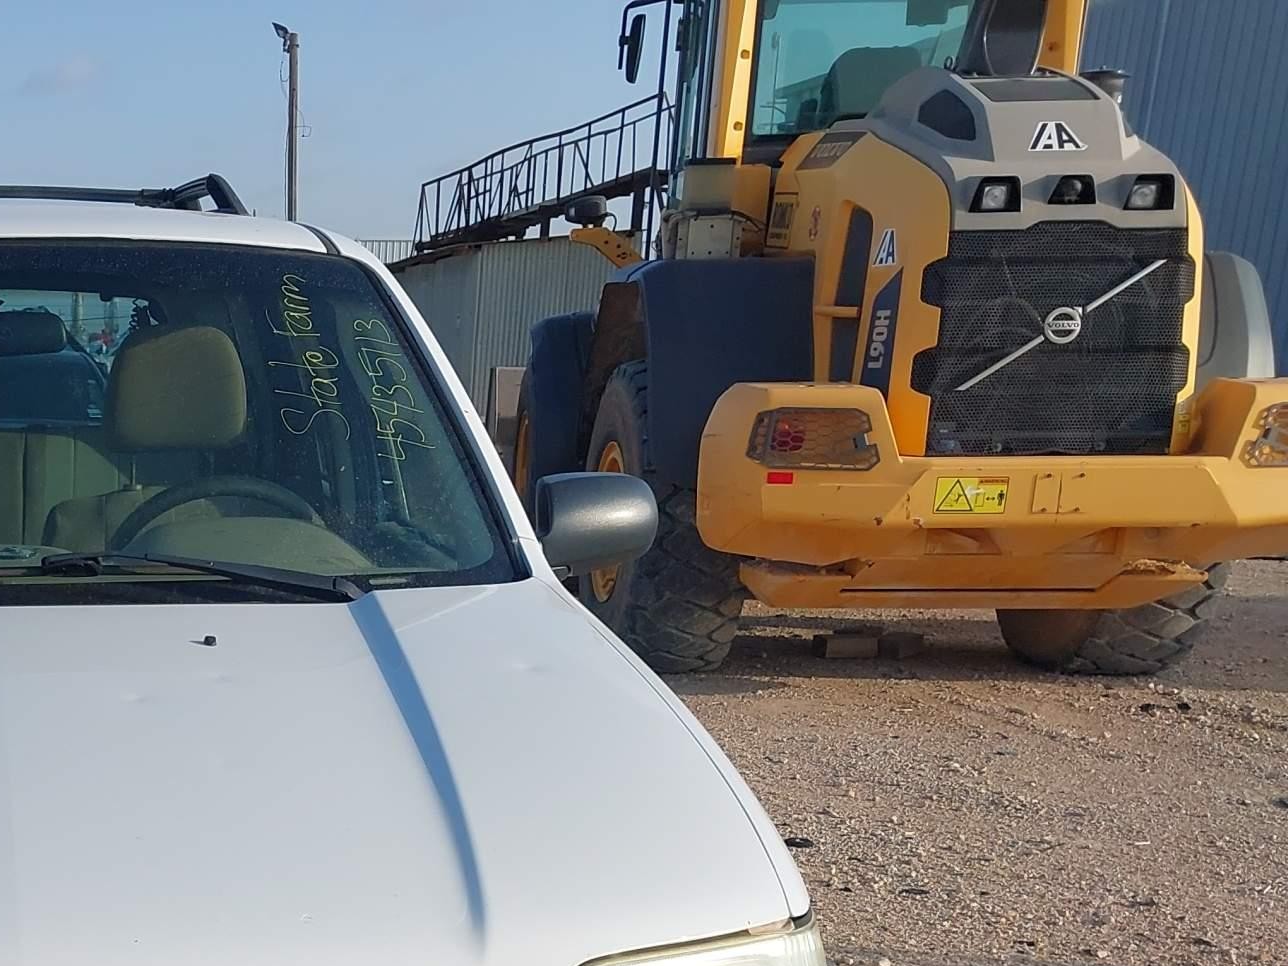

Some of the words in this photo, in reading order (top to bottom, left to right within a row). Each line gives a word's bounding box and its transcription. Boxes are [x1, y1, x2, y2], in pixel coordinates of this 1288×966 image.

[265, 274, 321, 337] Farm
[867, 309, 892, 369] L90H
[267, 346, 351, 441] State
